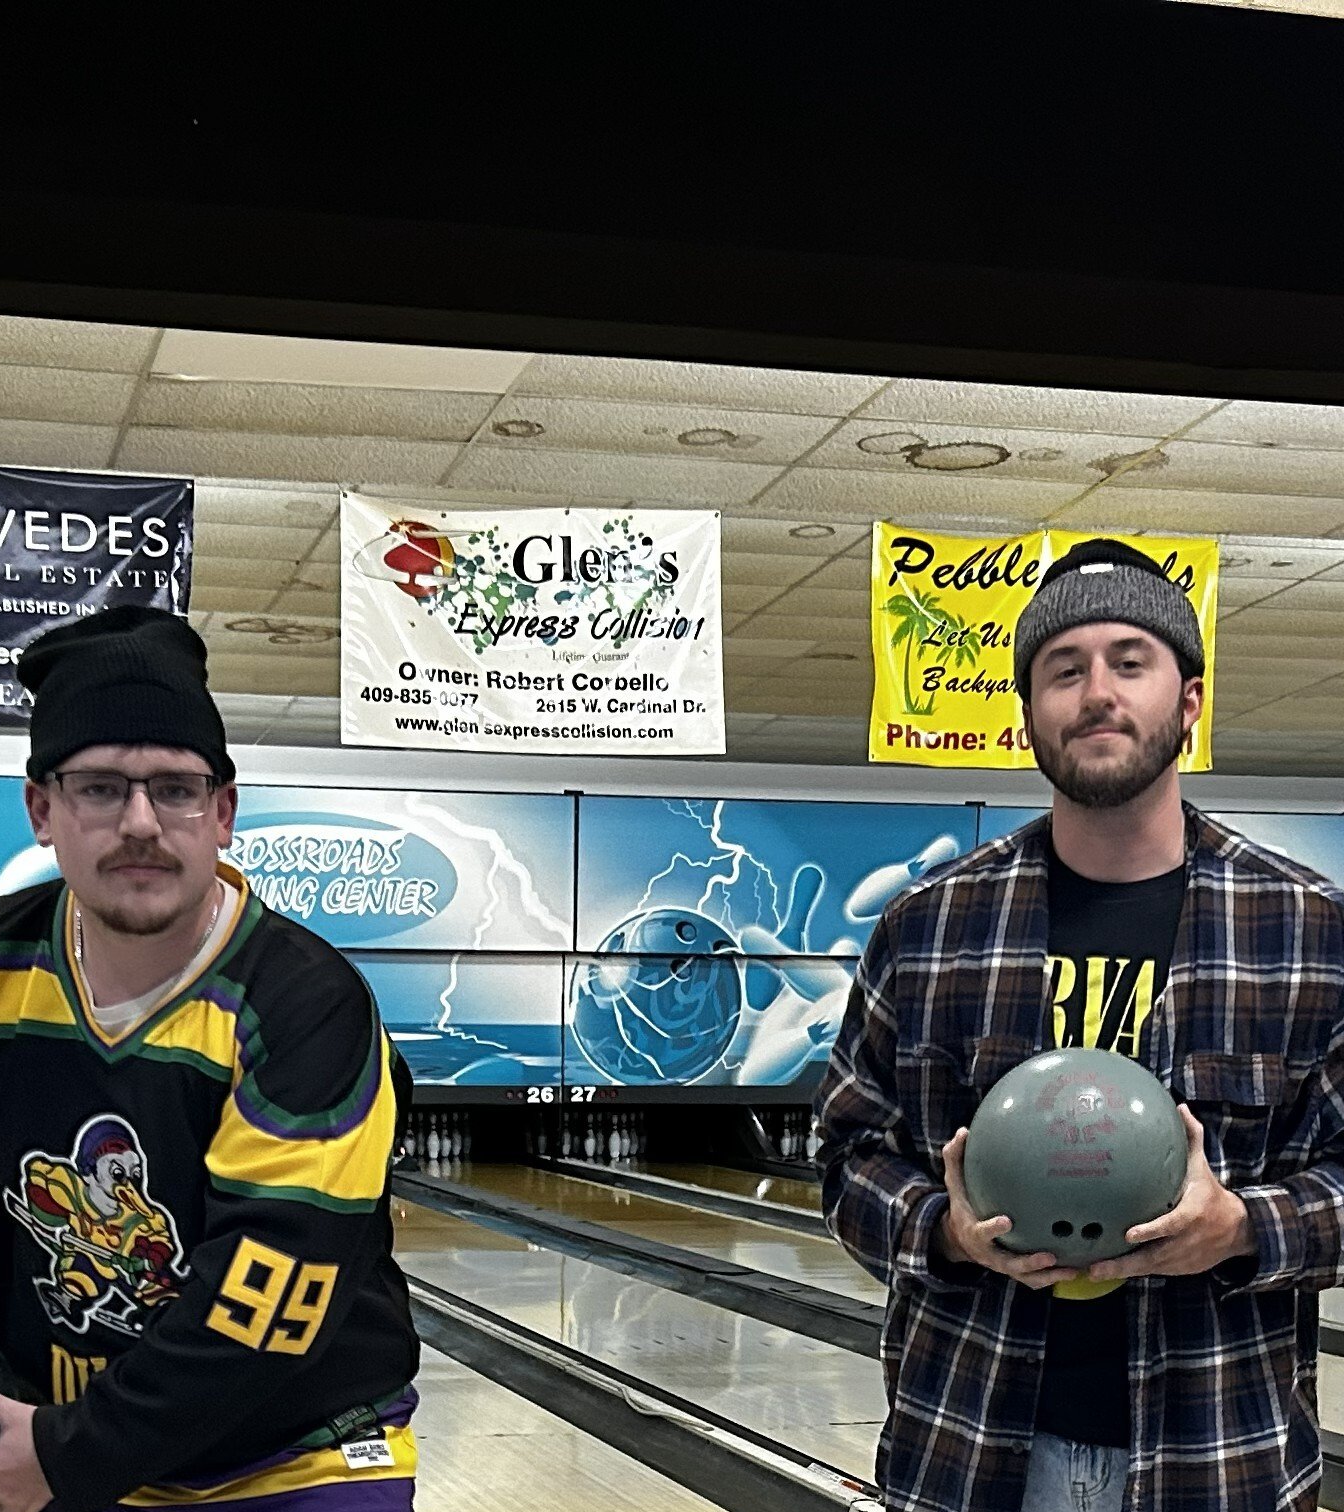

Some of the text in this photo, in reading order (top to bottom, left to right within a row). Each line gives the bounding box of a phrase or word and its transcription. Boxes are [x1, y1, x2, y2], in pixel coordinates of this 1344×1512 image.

[512, 534, 680, 584] Glen's
[42, 566, 171, 589] ESTATE
[76, 603, 97, 617] IN
[454, 602, 706, 647] Express Collision
[921, 619, 1012, 649] Let Us
[486, 669, 565, 692] Robert
[571, 672, 670, 692] Corbello
[535, 698, 707, 714] 2615 W. Cardinal Dr.
[886, 722, 987, 751] Phone:
[322, 876, 439, 918] CENTER
[526, 1086, 555, 1104] 26
[570, 1086, 597, 1103] 27
[206, 1236, 340, 1355] 99
